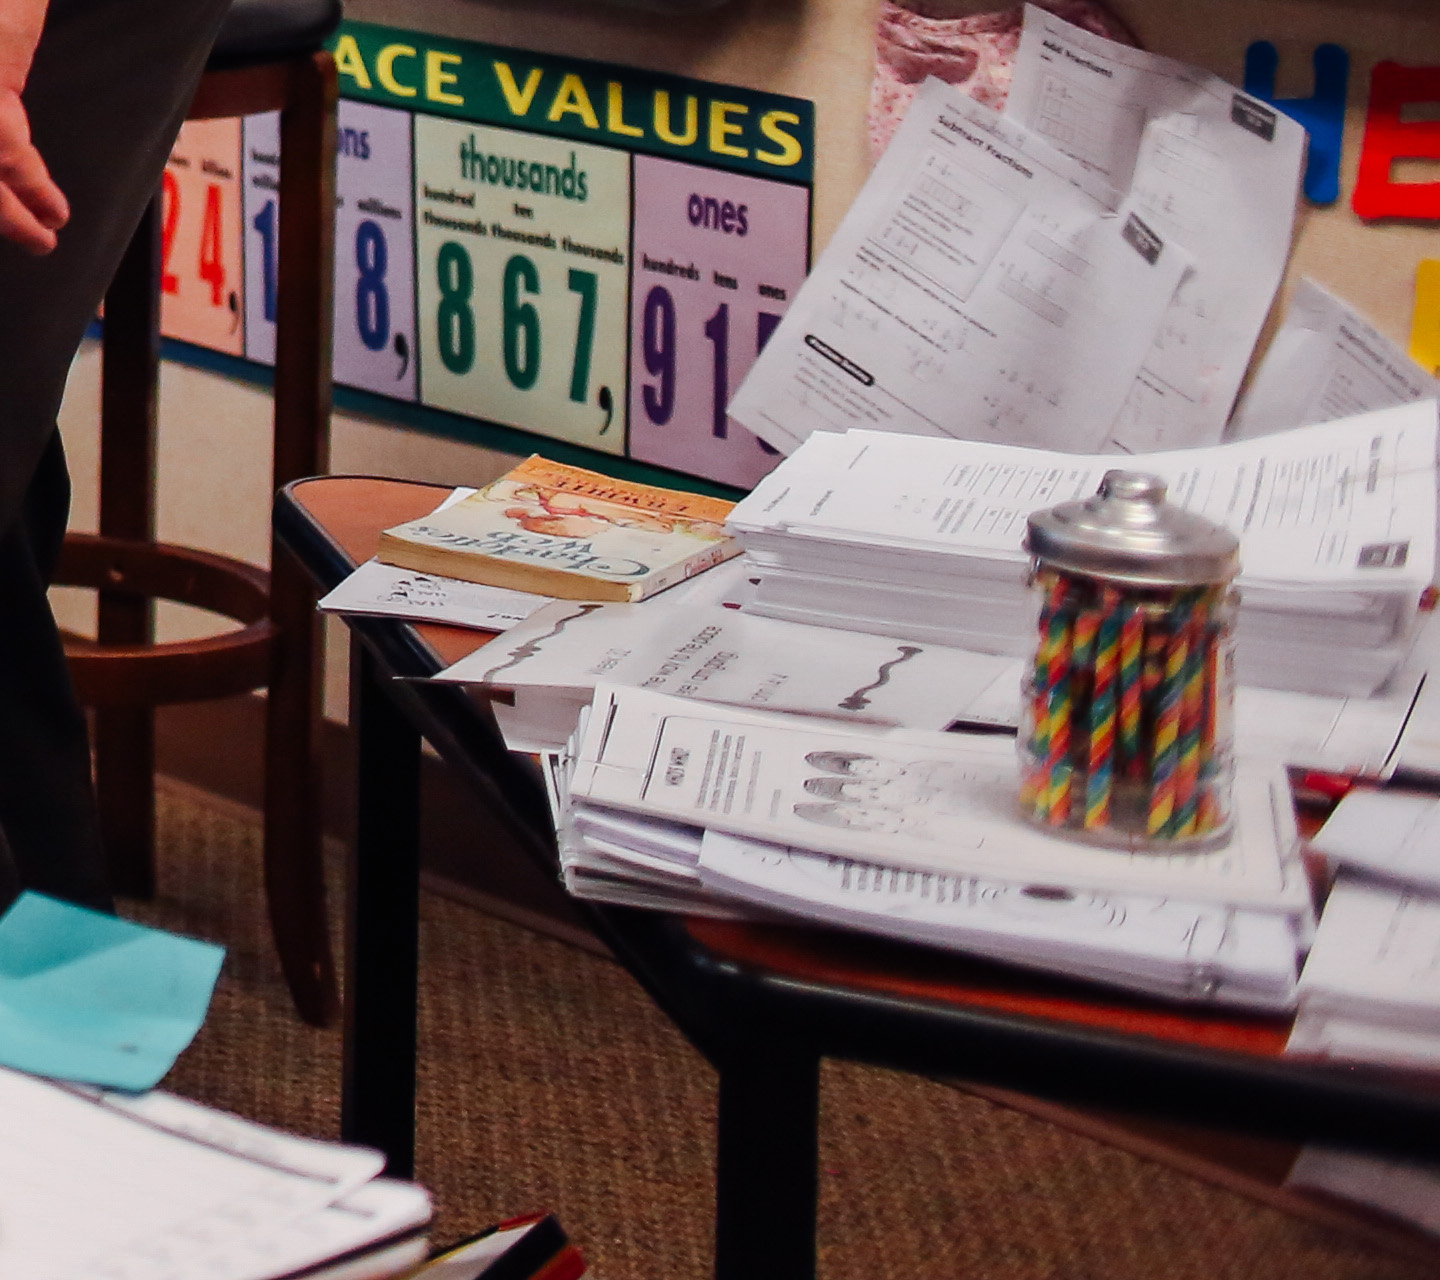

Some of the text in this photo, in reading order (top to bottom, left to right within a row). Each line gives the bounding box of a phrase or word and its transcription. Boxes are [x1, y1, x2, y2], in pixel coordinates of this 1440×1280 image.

[333, 34, 804, 168] ACE VALUES
[460, 134, 589, 203] thousands
[687, 193, 750, 237] ones
[641, 252, 701, 282] hundreds
[712, 269, 738, 291] tens
[411, 525, 650, 577] Charlotte's
[487, 530, 592, 554] Web
